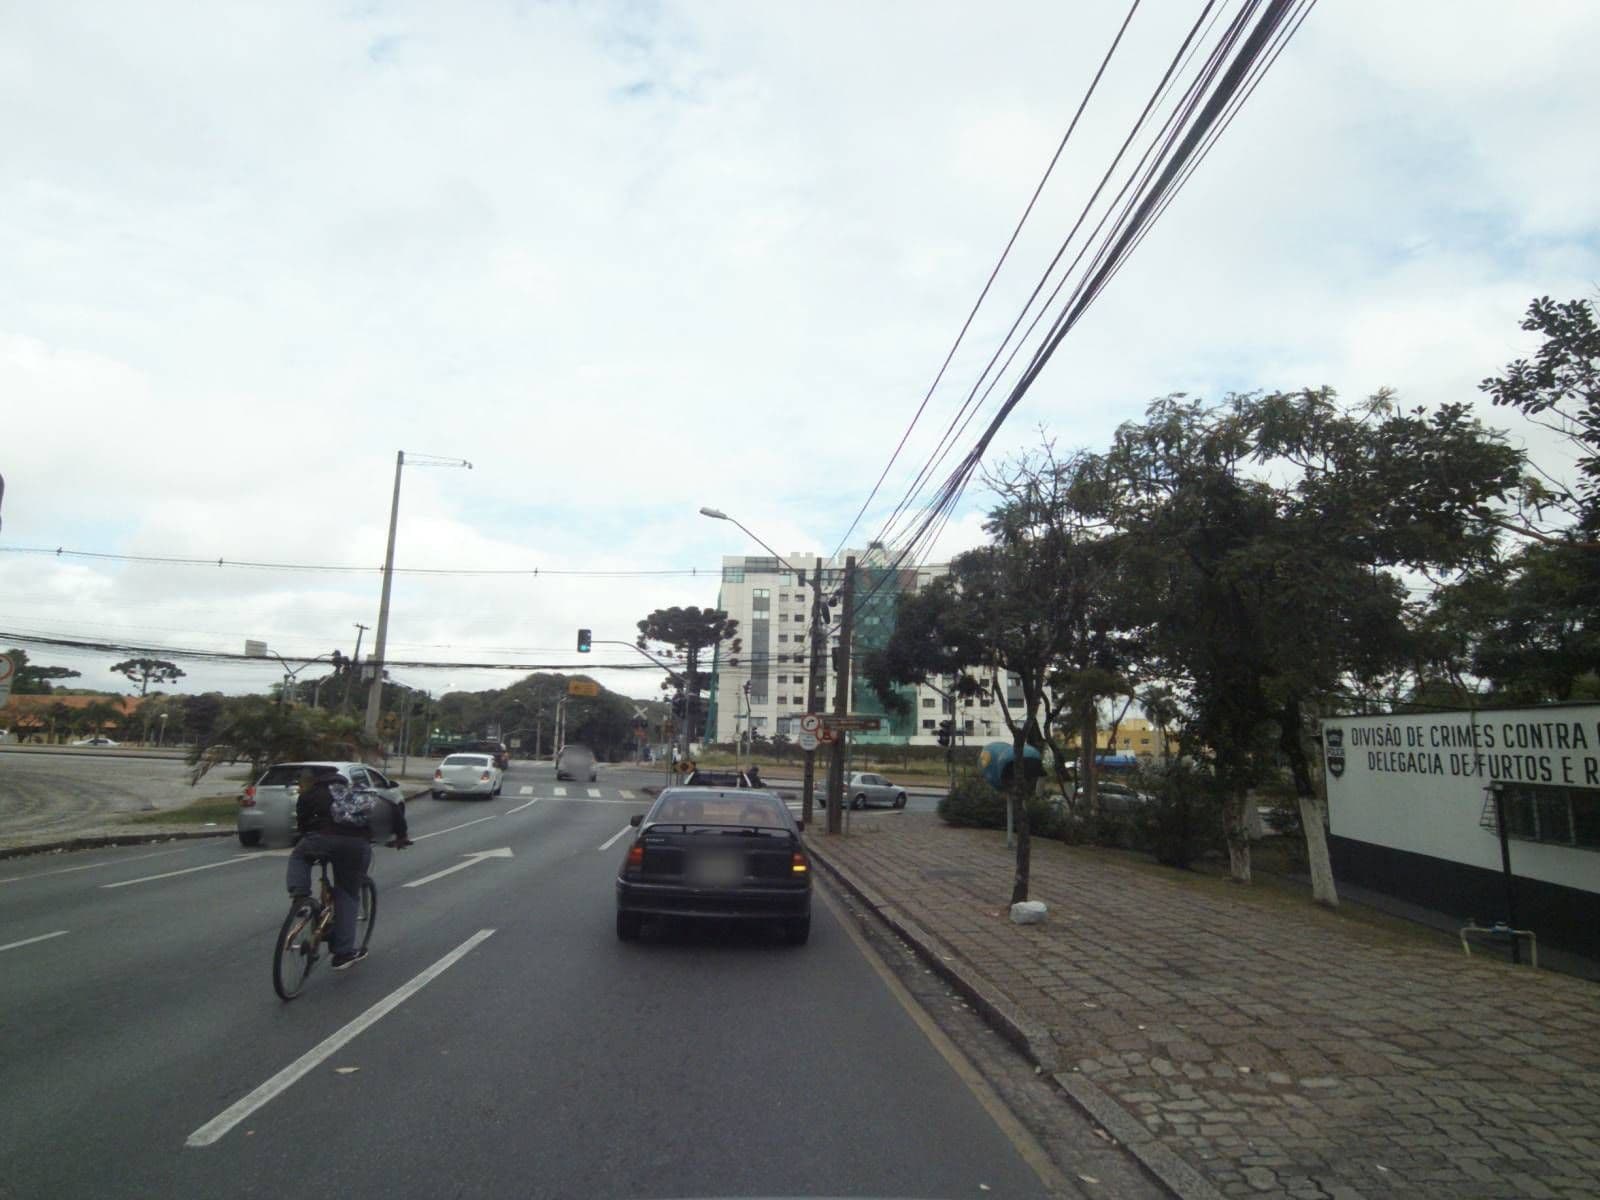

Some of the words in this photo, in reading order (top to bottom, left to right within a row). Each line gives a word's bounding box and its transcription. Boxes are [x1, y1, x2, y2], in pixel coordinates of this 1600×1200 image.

[1351, 723, 1401, 747] DIVISÃO
[1406, 726, 1424, 747] DE
[1430, 724, 1495, 748] CRIMES
[1502, 722, 1588, 749] CONTRA
[1368, 751, 1444, 775] DELEGACIA
[1450, 753, 1471, 777] DE
[1478, 753, 1552, 782] FURTOS
[1561, 755, 1575, 784] E
